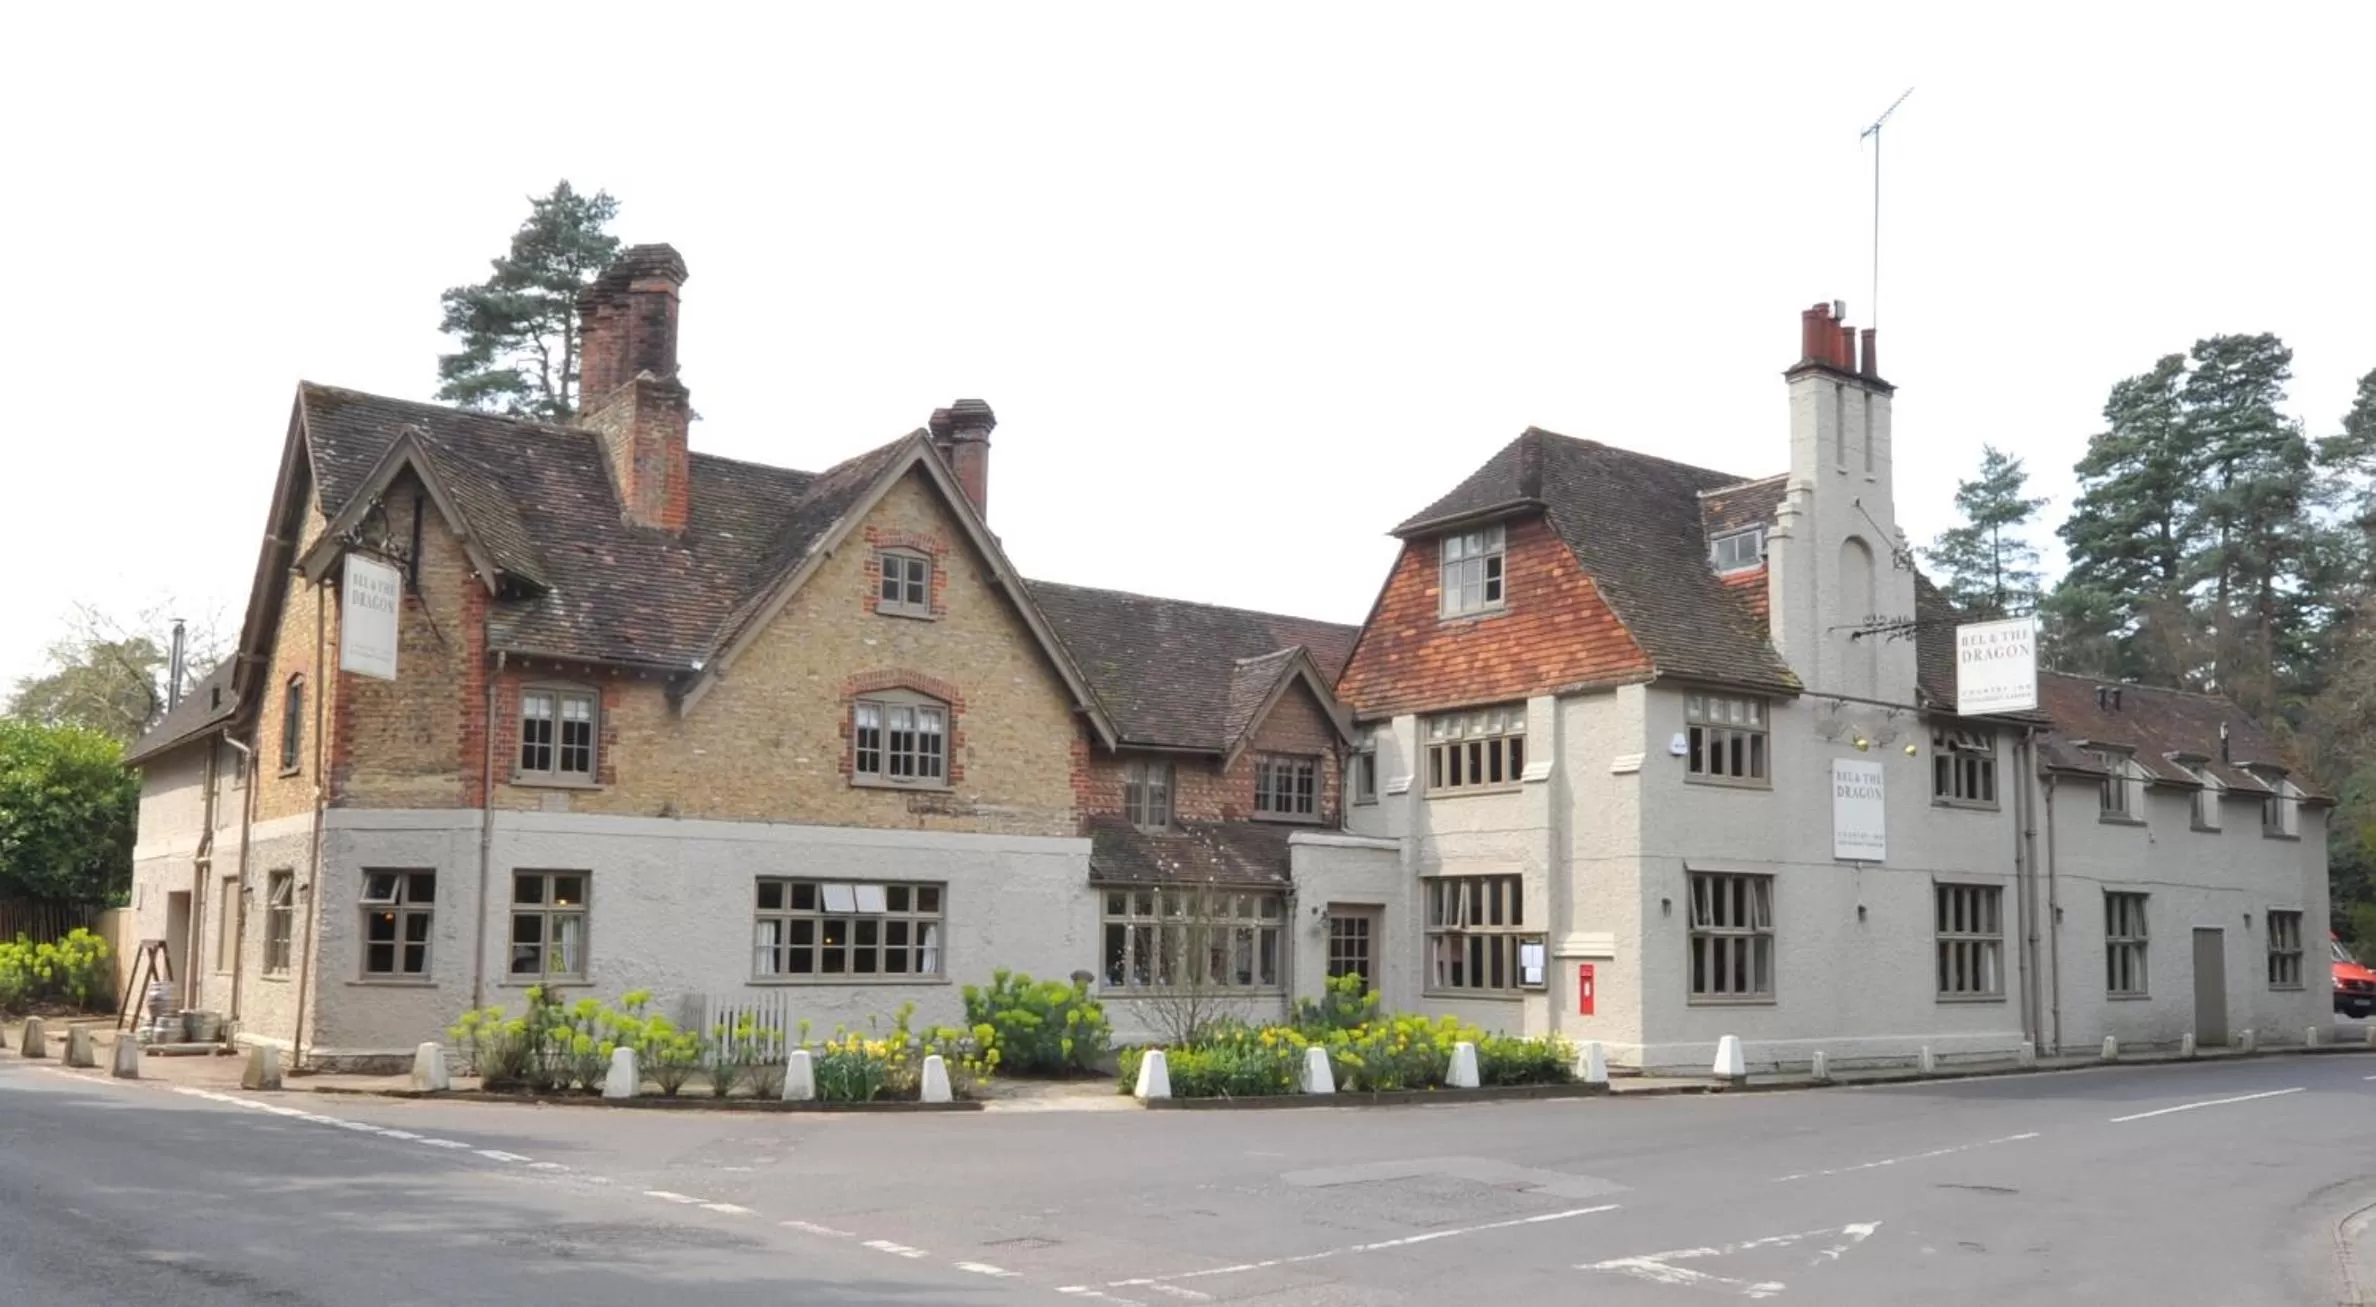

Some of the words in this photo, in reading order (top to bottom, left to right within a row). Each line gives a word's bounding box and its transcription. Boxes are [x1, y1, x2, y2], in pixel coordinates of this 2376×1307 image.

[352, 589, 394, 614] DRAGON
[1962, 634, 1986, 646] BEL
[1990, 633, 1998, 643] &
[2001, 628, 2027, 641] THE
[1962, 644, 2029, 664] DRAGON
[1837, 771, 1853, 782] BEL
[1863, 773, 1882, 785] THE
[1837, 785, 1882, 801] DRAGON
